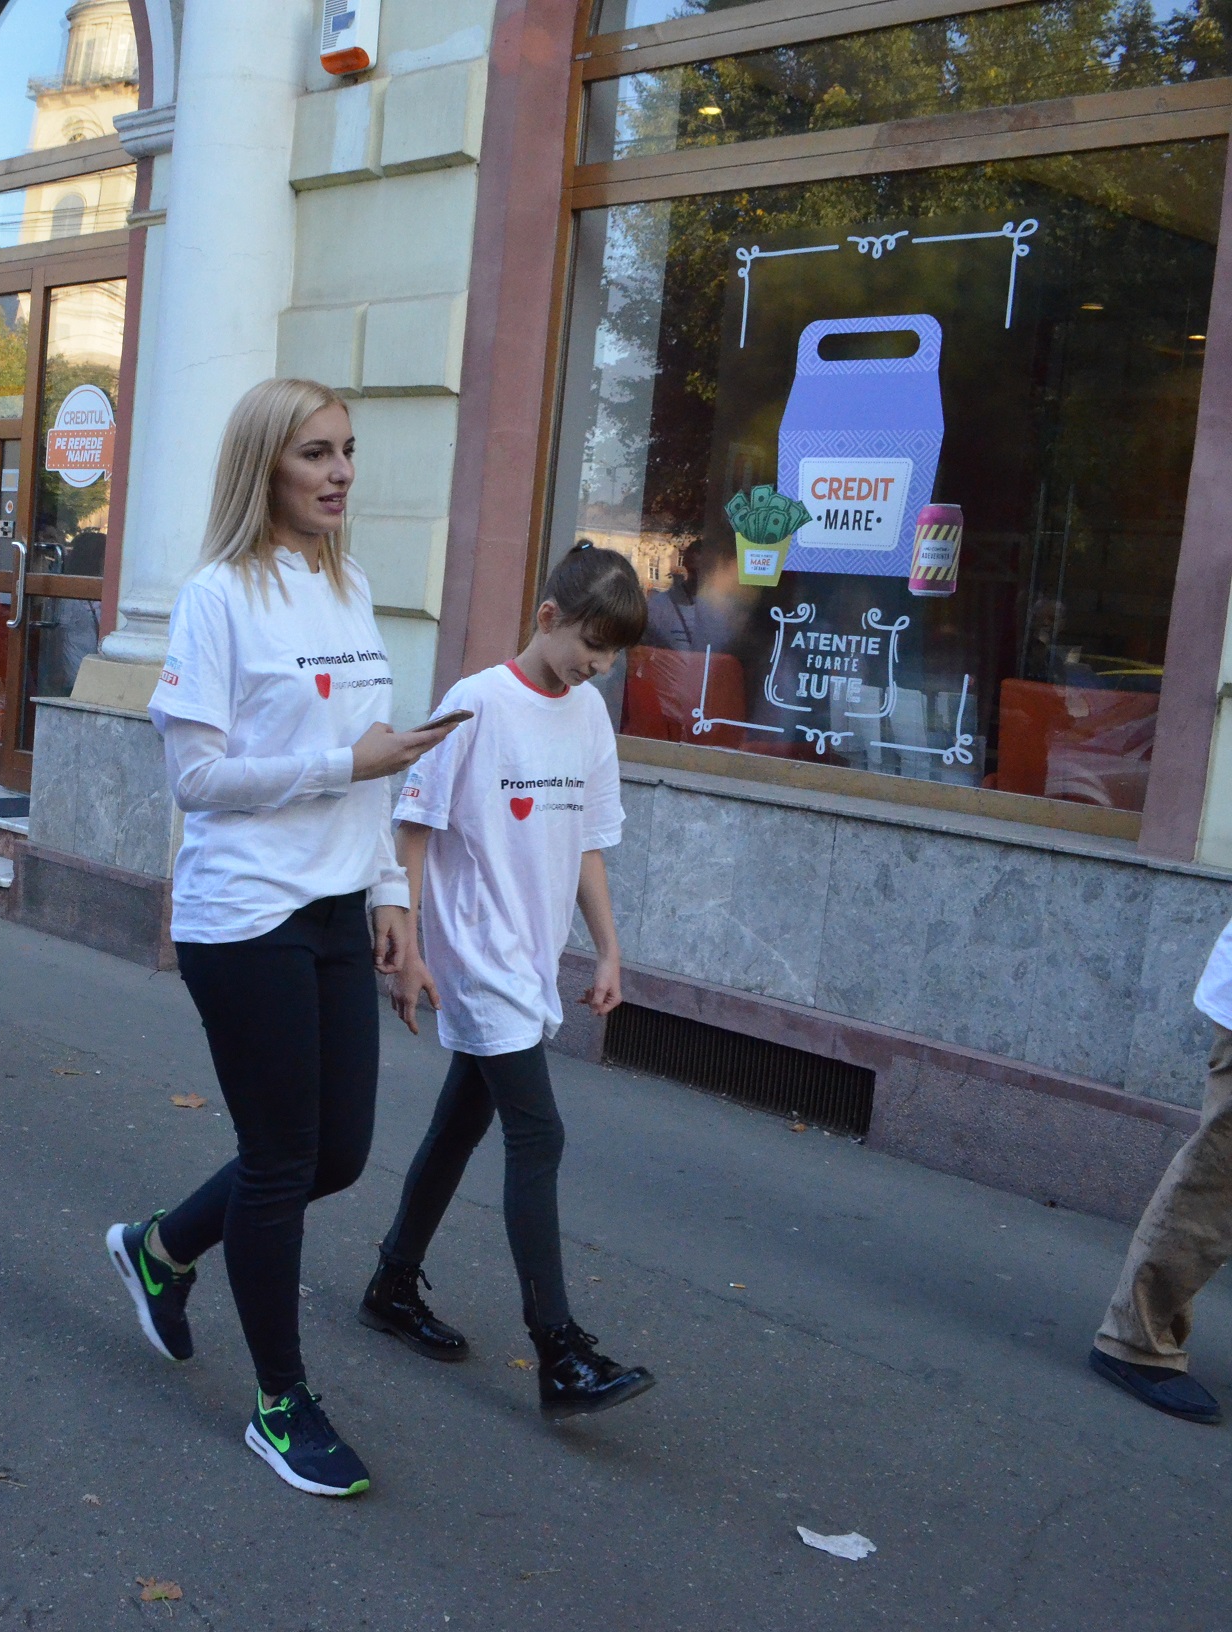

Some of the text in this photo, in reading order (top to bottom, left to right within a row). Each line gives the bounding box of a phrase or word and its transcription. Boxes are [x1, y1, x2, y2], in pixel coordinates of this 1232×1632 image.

[63, 410, 106, 425] CREDITUL
[54, 437, 104, 450] PE REPEDE
[65, 449, 102, 463] 'NAINTE
[810, 476, 895, 502] CREDIT
[824, 508, 875, 531] MARE
[750, 558, 771, 567] MARE
[790, 631, 882, 657] ATENȚIE
[296, 652, 356, 669] Promenada
[806, 654, 859, 672] FOARTE
[795, 672, 863, 703] IUTE
